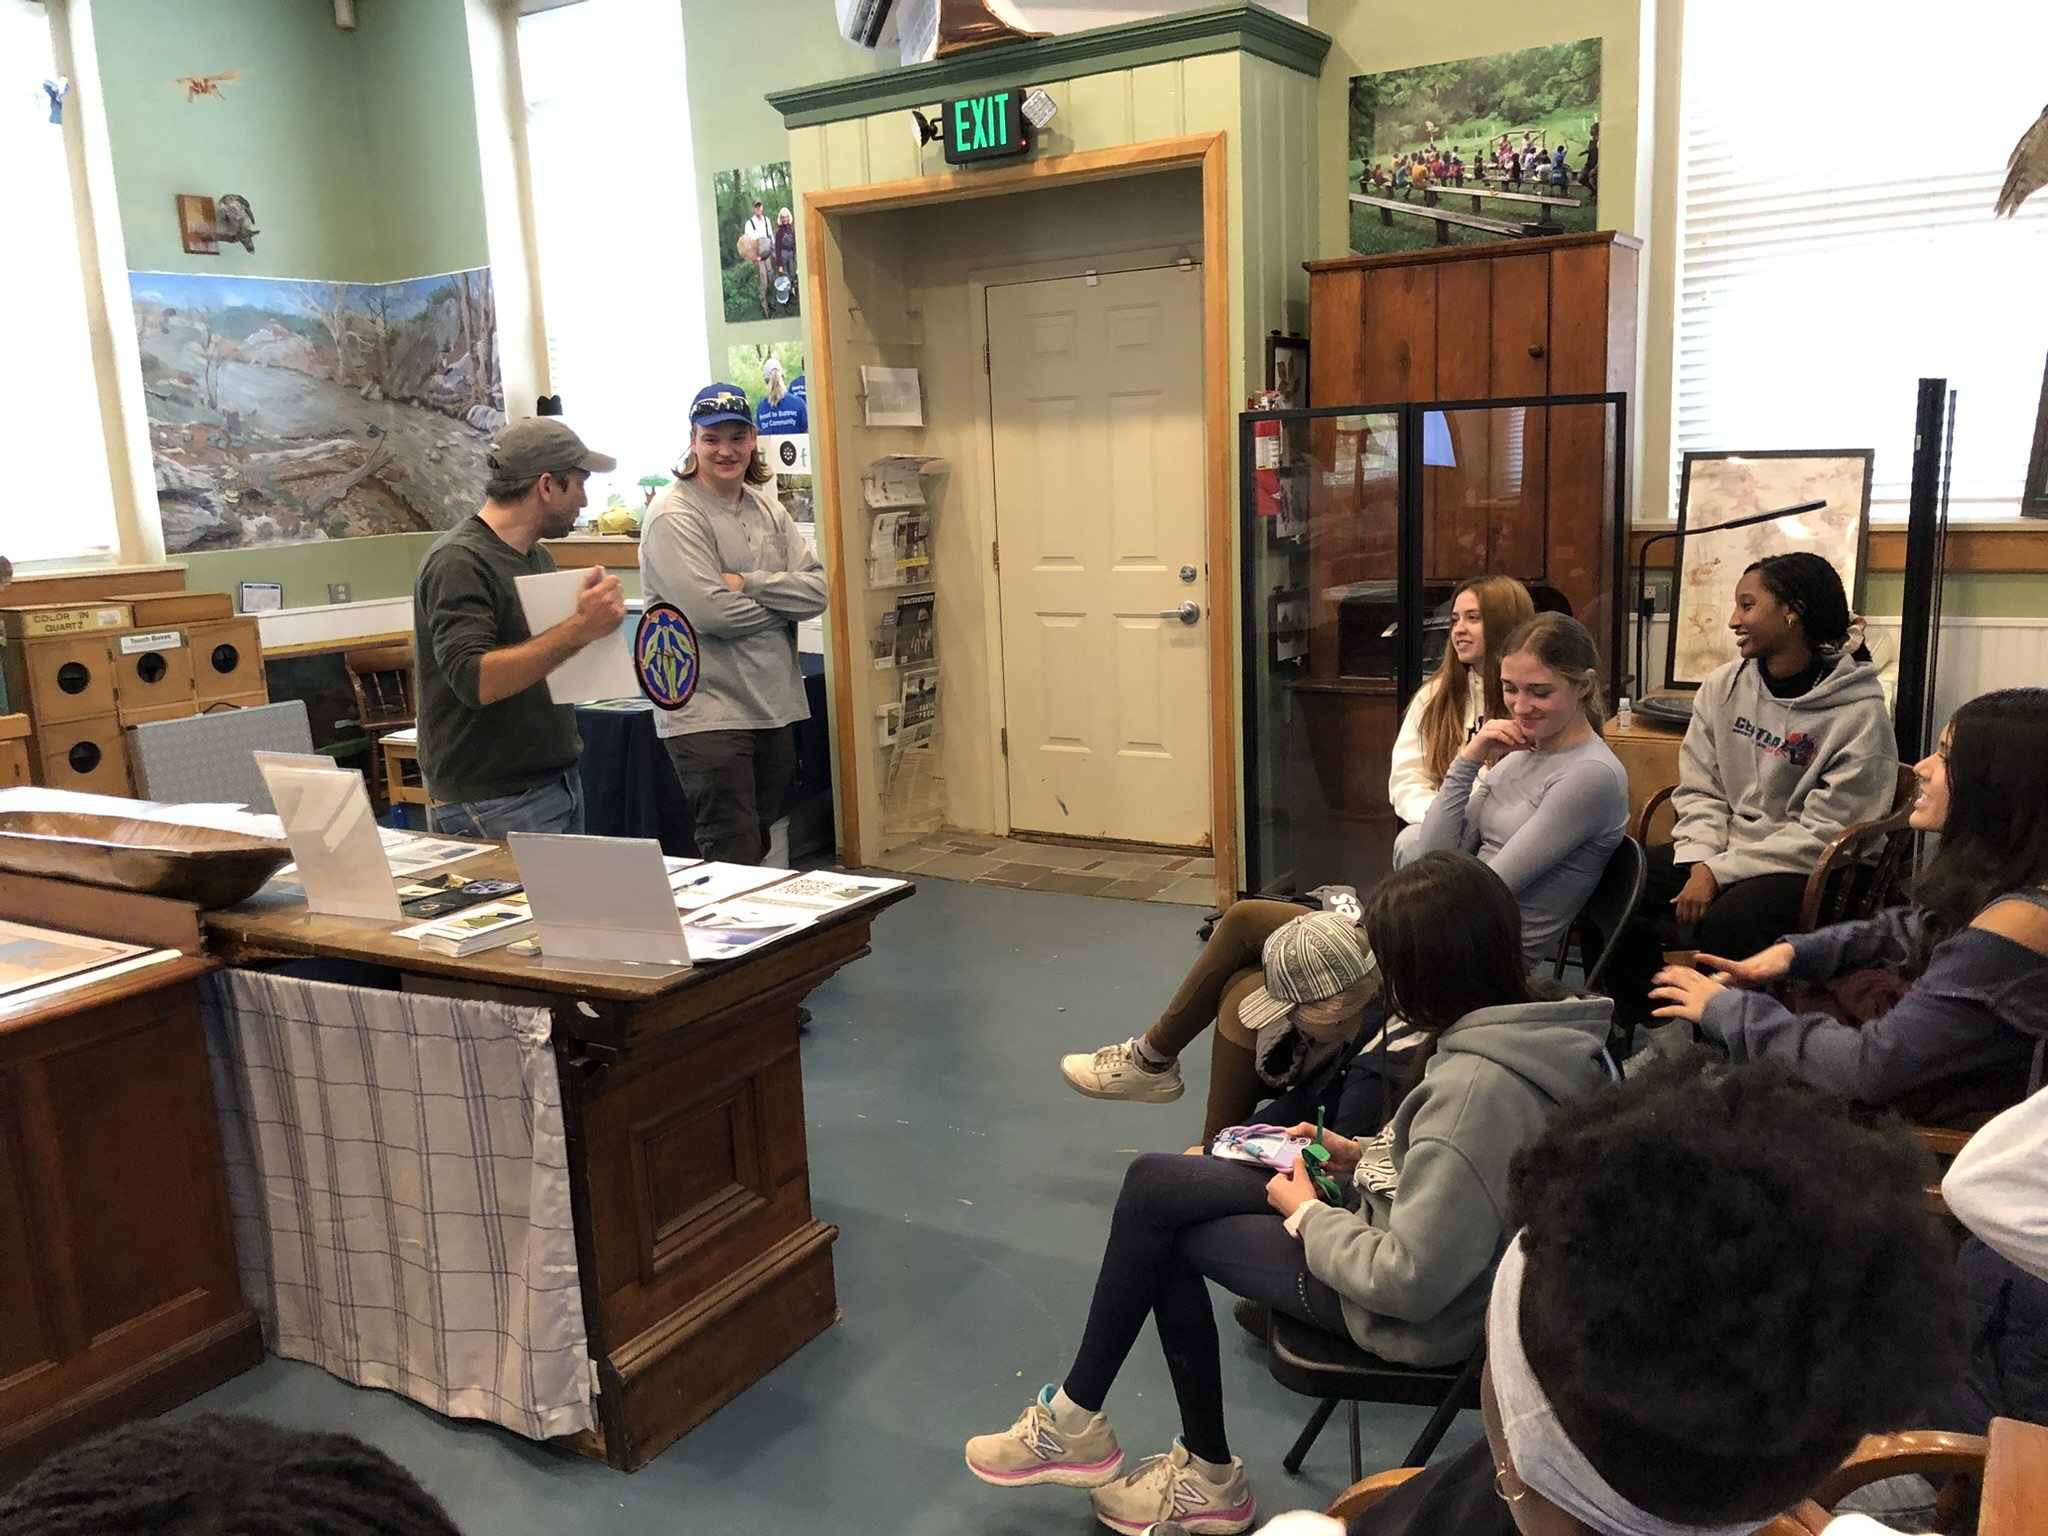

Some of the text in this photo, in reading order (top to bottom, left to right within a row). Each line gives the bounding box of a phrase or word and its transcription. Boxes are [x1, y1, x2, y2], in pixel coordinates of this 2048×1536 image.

[955, 93, 1009, 152] EXIT
[759, 411, 771, 421] Proud
[778, 410, 797, 418] Support
[769, 418, 796, 428] Community
[33, 611, 90, 624] COLOR IN
[44, 621, 84, 633] QUARTZ
[130, 634, 171, 645] Touch Boxes
